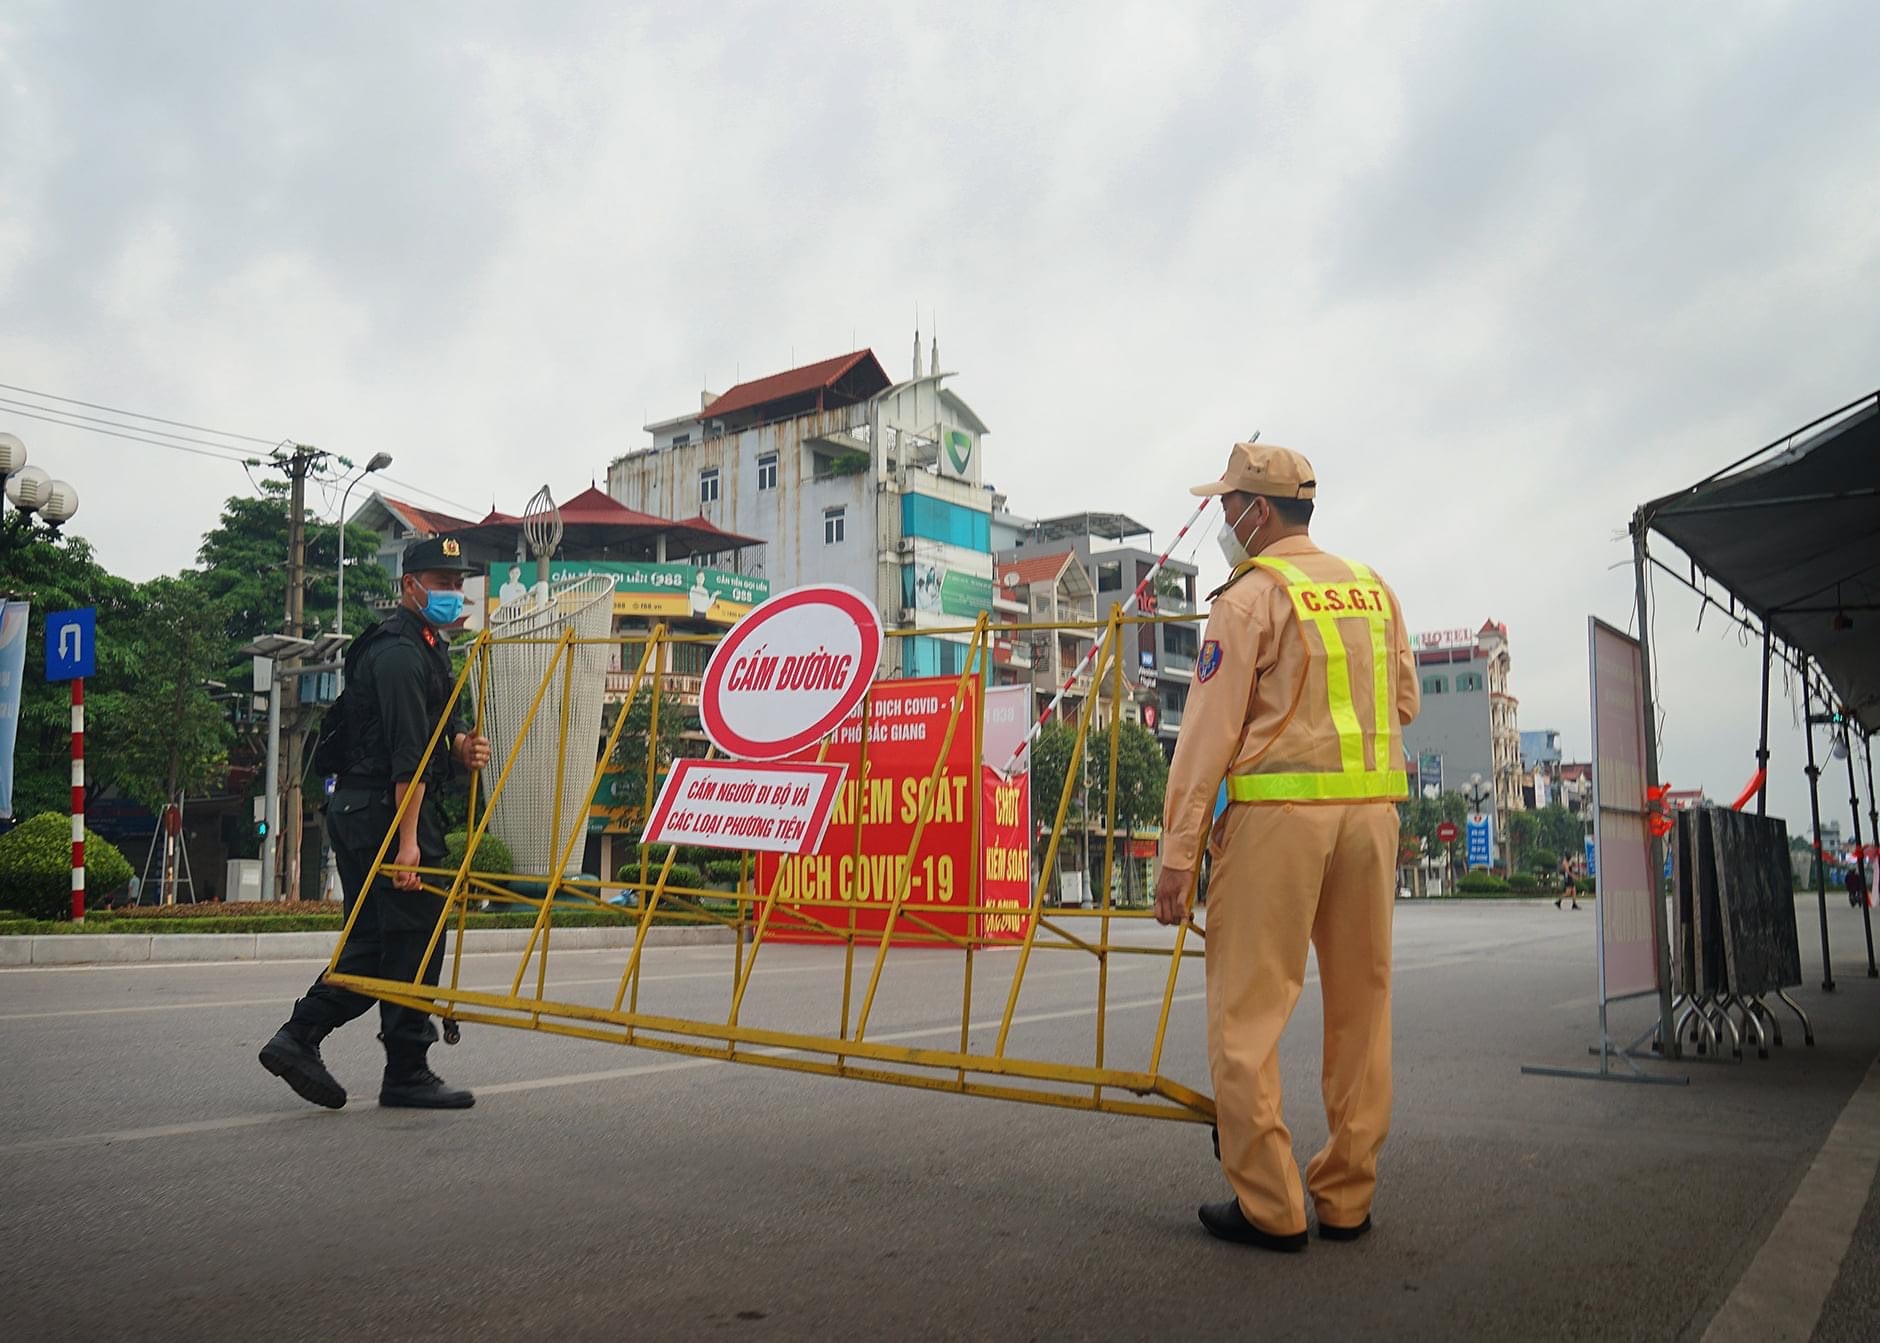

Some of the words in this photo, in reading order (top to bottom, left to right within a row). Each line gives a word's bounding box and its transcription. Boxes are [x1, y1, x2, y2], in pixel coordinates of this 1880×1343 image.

[1301, 588, 1384, 612] C.S.G.T
[1422, 629, 1472, 646] HOTEL
[727, 643, 780, 692] CẤM
[775, 645, 852, 691] ĐƯỜNG
[875, 699, 901, 720] DỊCH
[905, 697, 938, 715] COVID
[841, 722, 862, 744] PHỐ
[891, 723, 926, 741] GIANG
[687, 775, 718, 801] CẤM
[715, 779, 756, 803] NGƯỜI
[755, 784, 772, 805] ĐI
[772, 782, 792, 810] BỘ
[791, 783, 810, 807] VÀ
[831, 760, 893, 825] KIỂM
[901, 766, 968, 825] SOÁT
[994, 778, 1021, 828] CHỐT
[667, 807, 693, 832] CÁC
[692, 814, 722, 838] LOẠI
[721, 815, 774, 839] PHƯƠNG
[774, 816, 806, 844] TIỆN
[986, 834, 1006, 882] KIỂM
[1006, 842, 1029, 883] SOÁT
[778, 854, 832, 910] DỊCH
